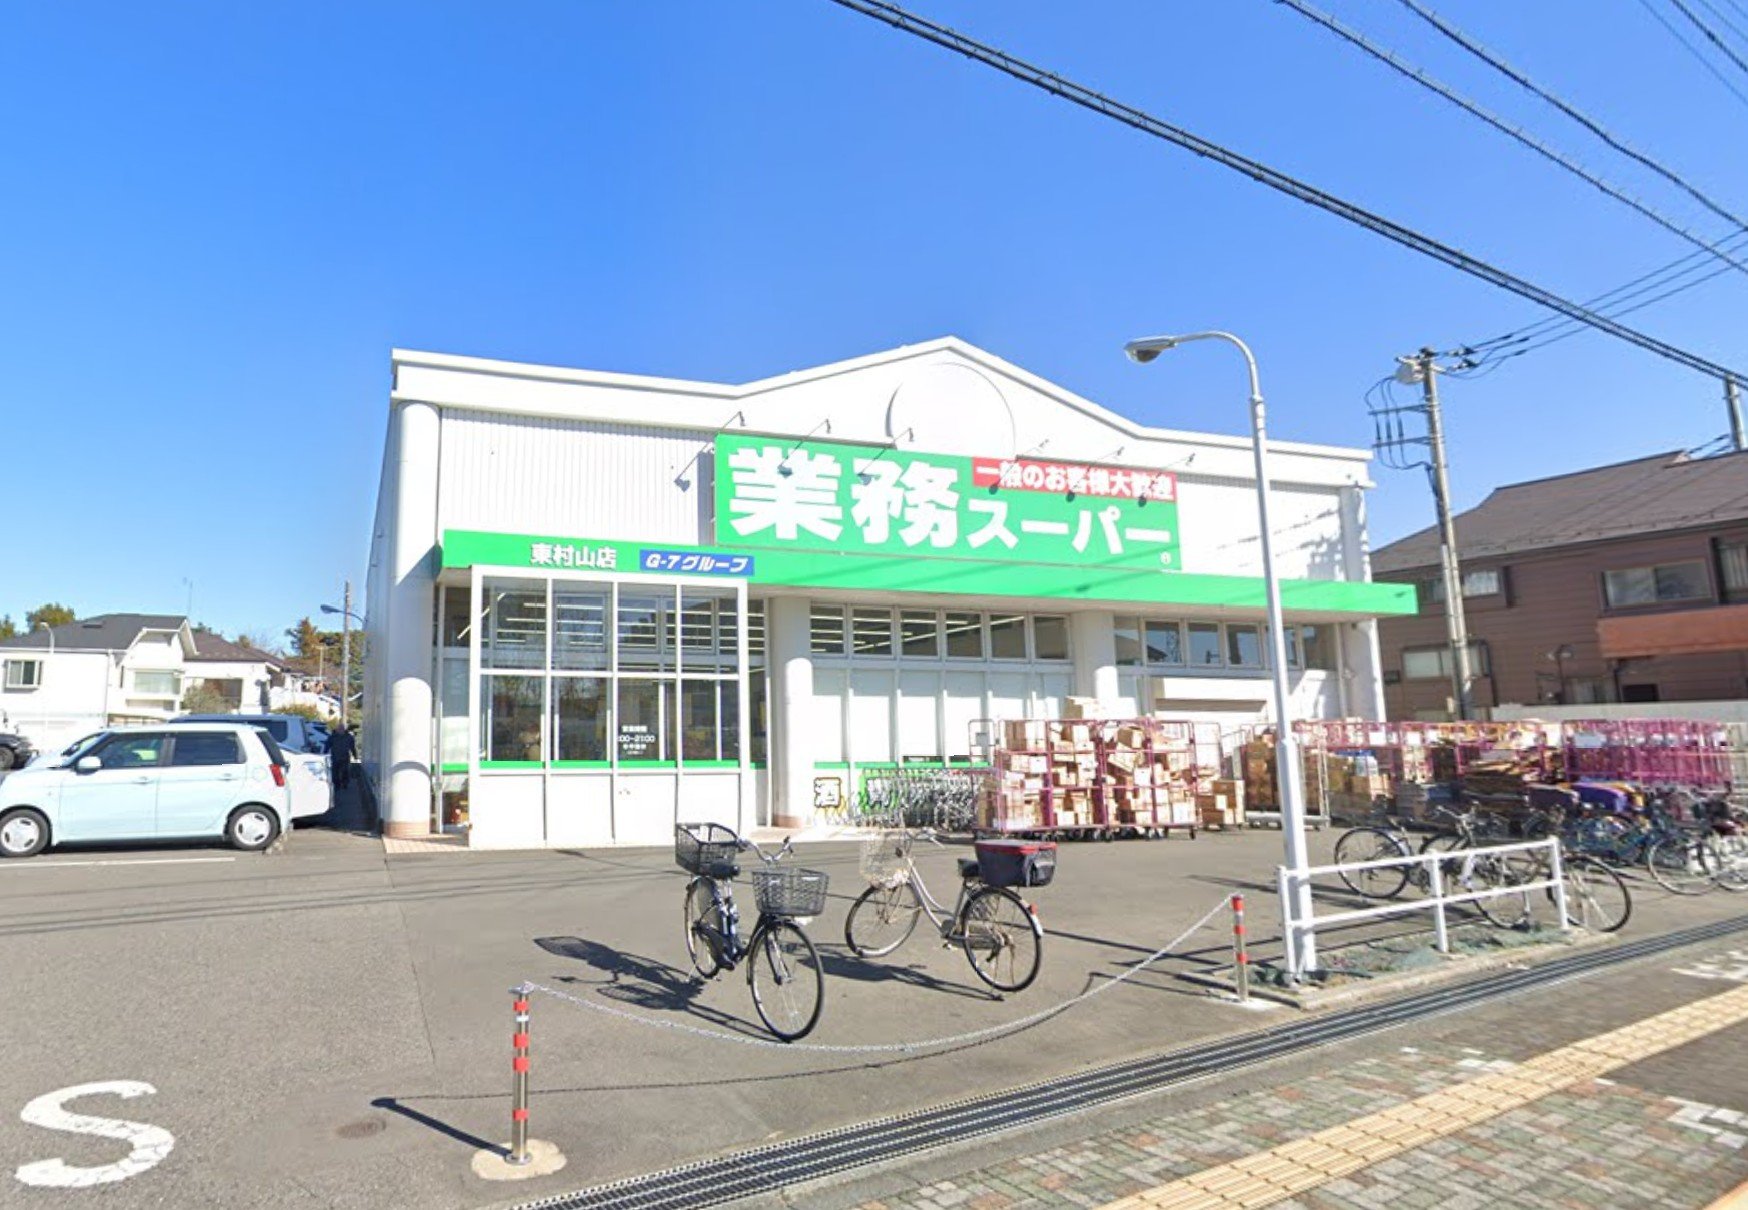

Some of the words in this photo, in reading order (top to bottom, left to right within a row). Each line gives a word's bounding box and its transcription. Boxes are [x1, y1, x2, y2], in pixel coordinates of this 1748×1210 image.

[728, 446, 1172, 557] 業務スーパー
[531, 543, 617, 569] 東村山店
[16, 1081, 175, 1187] S
